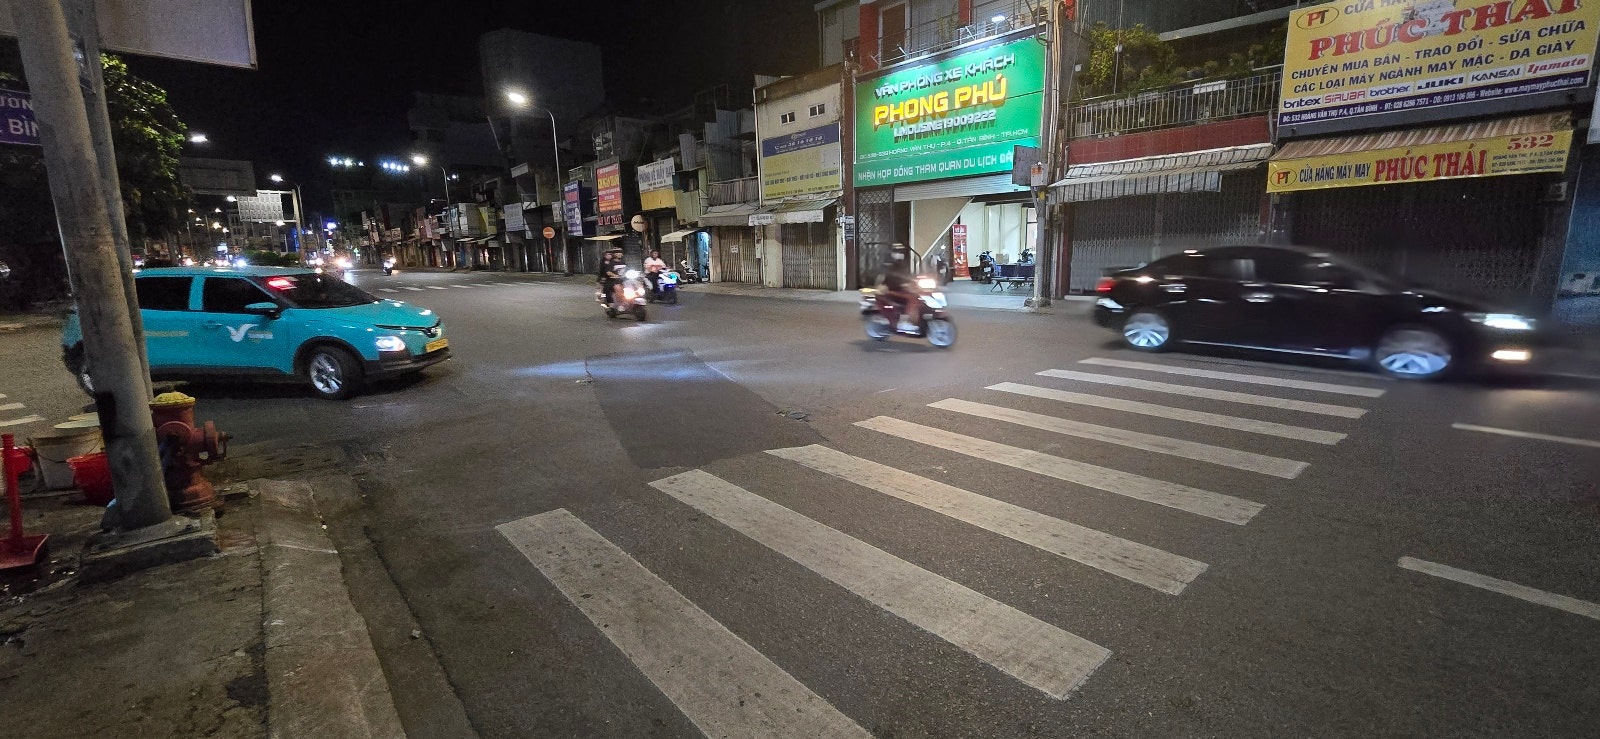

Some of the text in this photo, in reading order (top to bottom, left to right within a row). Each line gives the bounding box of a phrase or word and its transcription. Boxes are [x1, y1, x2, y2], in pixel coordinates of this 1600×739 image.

[1307, 9, 1330, 27] PT
[1308, 17, 1431, 61] PHÚC
[875, 53, 1015, 98] VĂN PHÒNG XE KHÁCH
[1291, 63, 1338, 80] CHUYÊN
[1342, 59, 1369, 72] MUA
[1373, 53, 1401, 67] BÁN
[1415, 45, 1452, 60] TRAO
[1293, 81, 1316, 94] CÁC
[1319, 77, 1346, 90] LOẠI
[1349, 71, 1376, 85] MÁY
[1379, 66, 1423, 81] NGÀNH
[1427, 60, 1457, 73] MAY
[1509, 48, 1531, 61] DA
[1536, 38, 1576, 56] GIÀY
[874, 73, 1007, 128] PHONG PHÚ
[1283, 97, 1322, 109] britex
[1369, 84, 1411, 97] brother
[1417, 77, 1464, 90] JUKI
[1470, 67, 1521, 82] KANSAI
[8, 115, 39, 137] BÌN
[1507, 134, 1554, 151] 532
[858, 169, 876, 181] NHẬN
[915, 163, 937, 175] THAM
[938, 162, 961, 173] QUAN
[963, 158, 976, 168] DU
[977, 154, 997, 168] LỊCH
[1276, 170, 1291, 185] PT
[1299, 164, 1313, 182] CỬA
[1315, 163, 1335, 181] HÀNG
[1336, 161, 1353, 179] MÁY
[1354, 163, 1371, 178] MAY
[1373, 150, 1428, 182] PHÚC
[1433, 143, 1488, 178] THÁI
